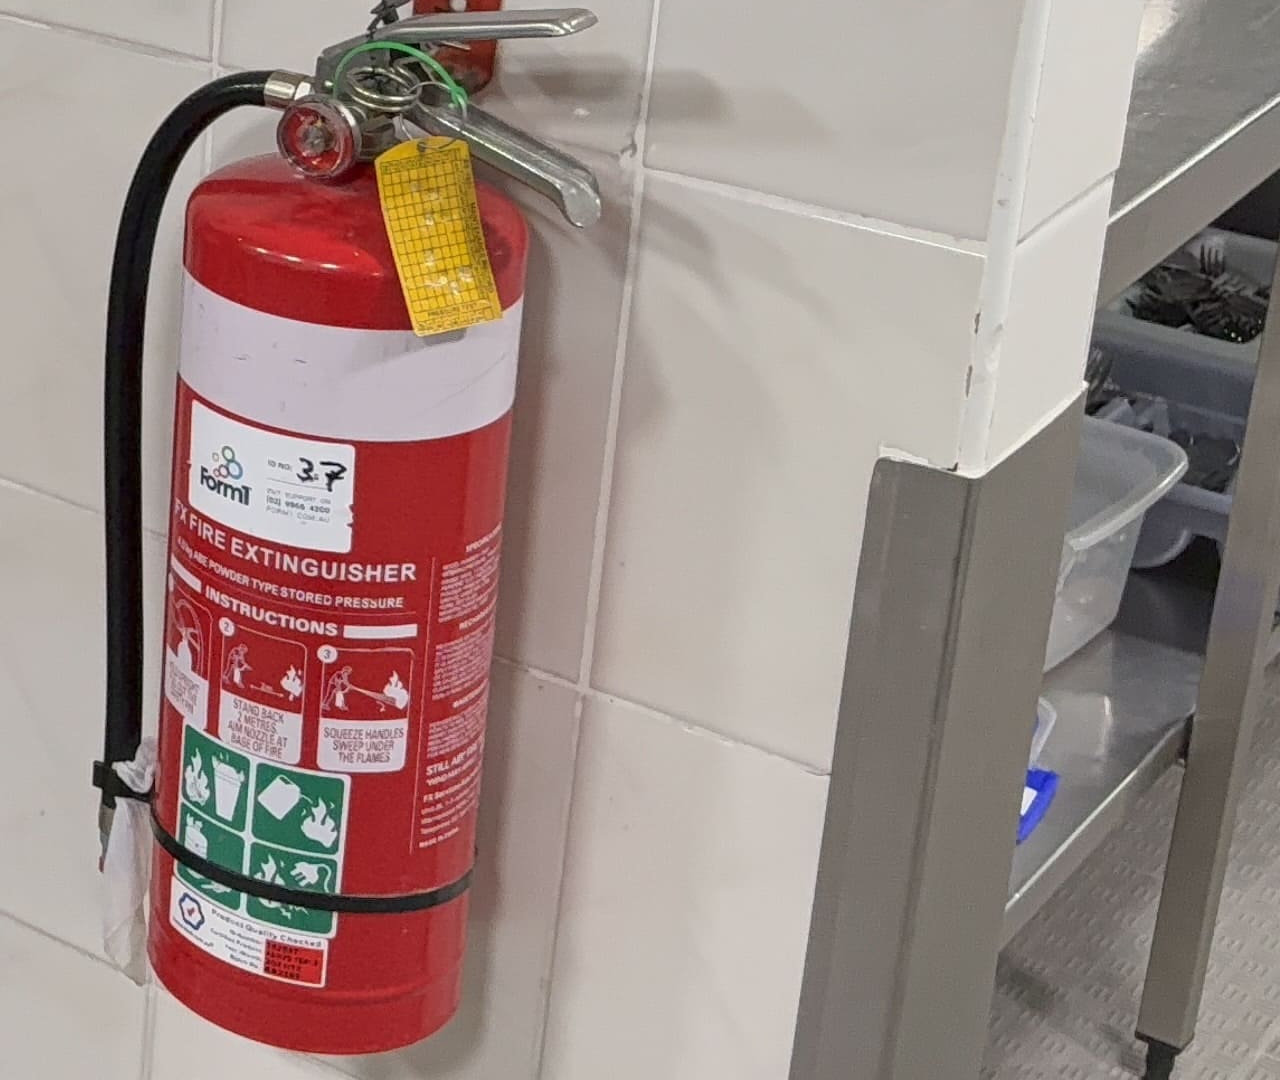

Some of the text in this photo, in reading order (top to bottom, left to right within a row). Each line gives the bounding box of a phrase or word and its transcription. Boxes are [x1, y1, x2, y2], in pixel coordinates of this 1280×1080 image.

[175, 498, 416, 583] FX FIRE EXTINGUISHER
[209, 560, 250, 586] POWDER
[251, 577, 278, 596] TYPE
[280, 587, 332, 606] STORED
[335, 596, 404, 609] PRESSURE
[205, 585, 338, 637] INSTRUCTIONS
[223, 622, 230, 632] 2
[323, 649, 331, 659] 3
[233, 699, 285, 723] STAND BACK
[237, 710, 242, 722] 2
[227, 721, 288, 747] AIM NOZZLE AT
[323, 728, 404, 739] SQUEEZE HANDLES
[332, 739, 394, 751] SWEEP UNDER
[230, 733, 282, 759] BASE OF FIRE
[339, 751, 391, 764] THE FLAMES
[212, 908, 322, 948] Product Quality Checked
